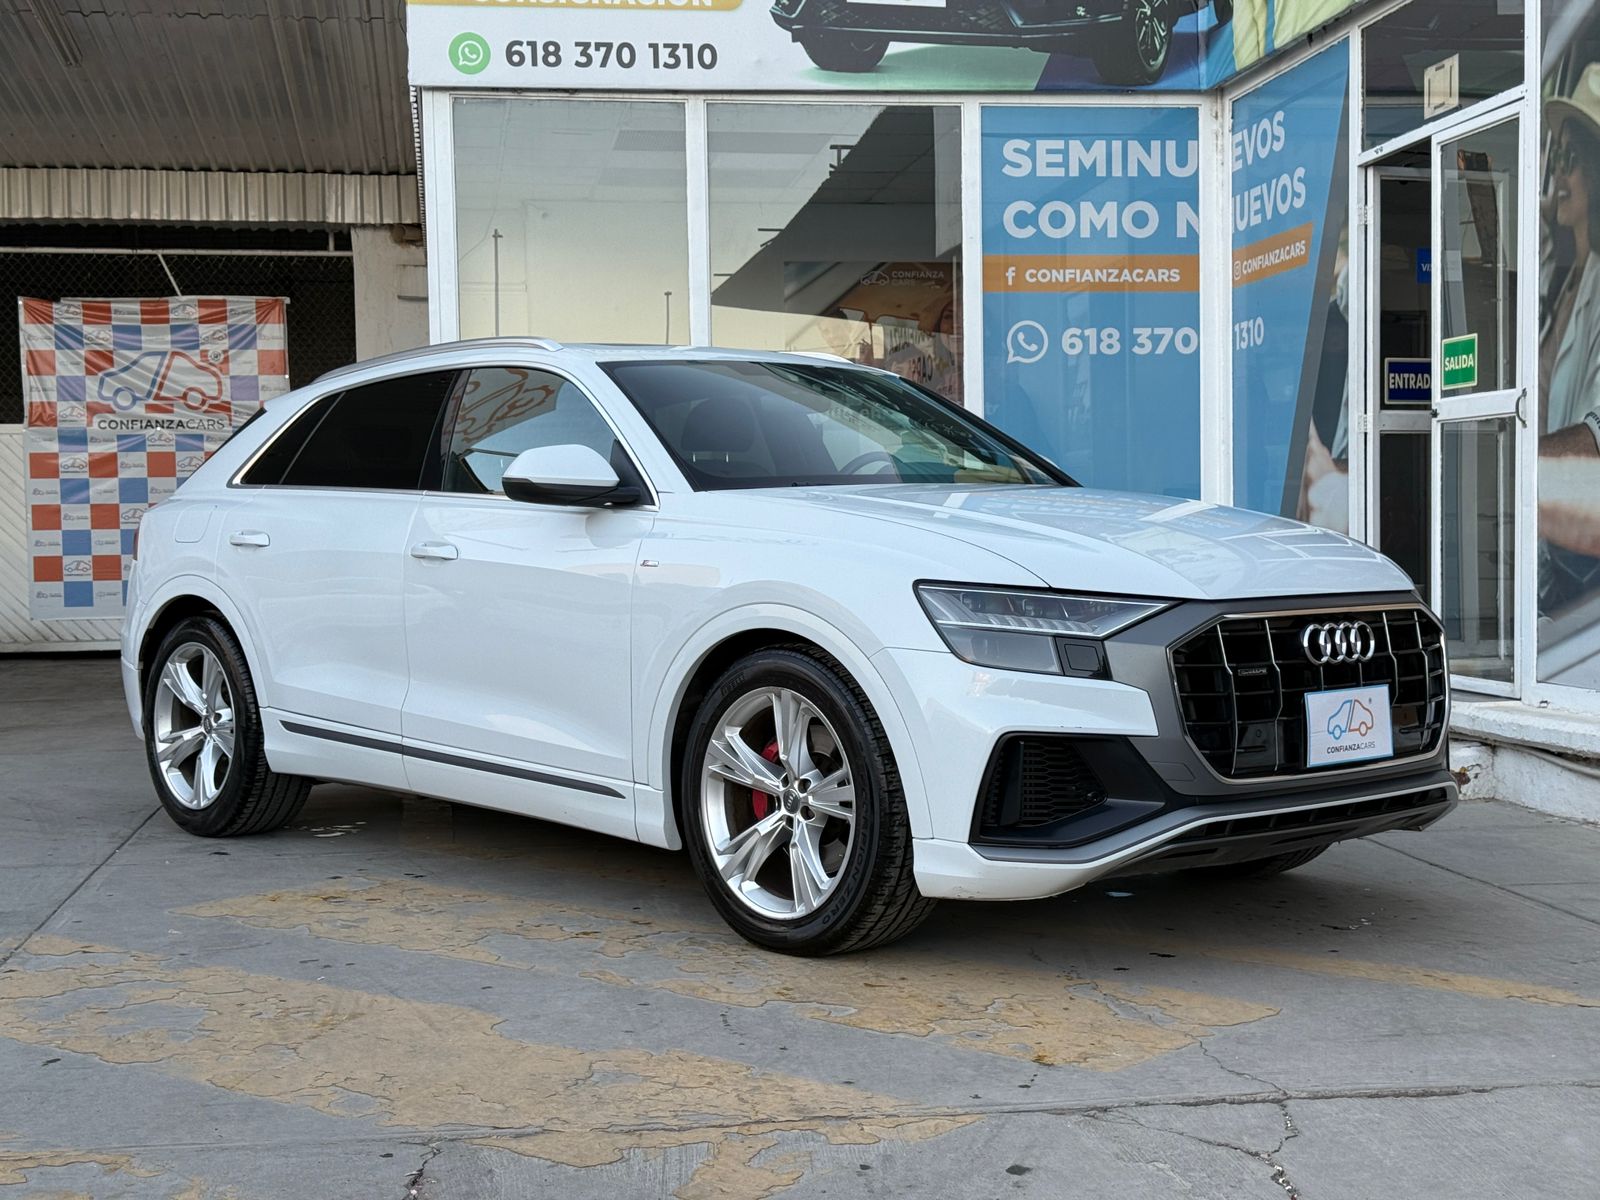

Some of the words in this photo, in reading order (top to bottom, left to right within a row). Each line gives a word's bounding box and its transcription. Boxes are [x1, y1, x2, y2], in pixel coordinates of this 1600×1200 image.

[505, 40, 562, 67] 618
[574, 41, 636, 68] 370
[648, 42, 718, 69] 1310
[1001, 139, 1199, 178] SEMINU
[1002, 200, 1159, 239] COMO
[1242, 240, 1306, 275] CONFIANZACARS
[891, 270, 944, 279] CONFIANZA
[1025, 268, 1181, 283] CONFIANZACARS
[1061, 327, 1121, 356] 618
[1131, 327, 1198, 355] 370
[1235, 316, 1264, 350] 1310
[1444, 353, 1475, 371] SALIDA
[1389, 373, 1432, 389] ENTRAD
[98, 418, 225, 431] CONFIANZACARS
[1327, 740, 1376, 755] CONFIANZACARS
